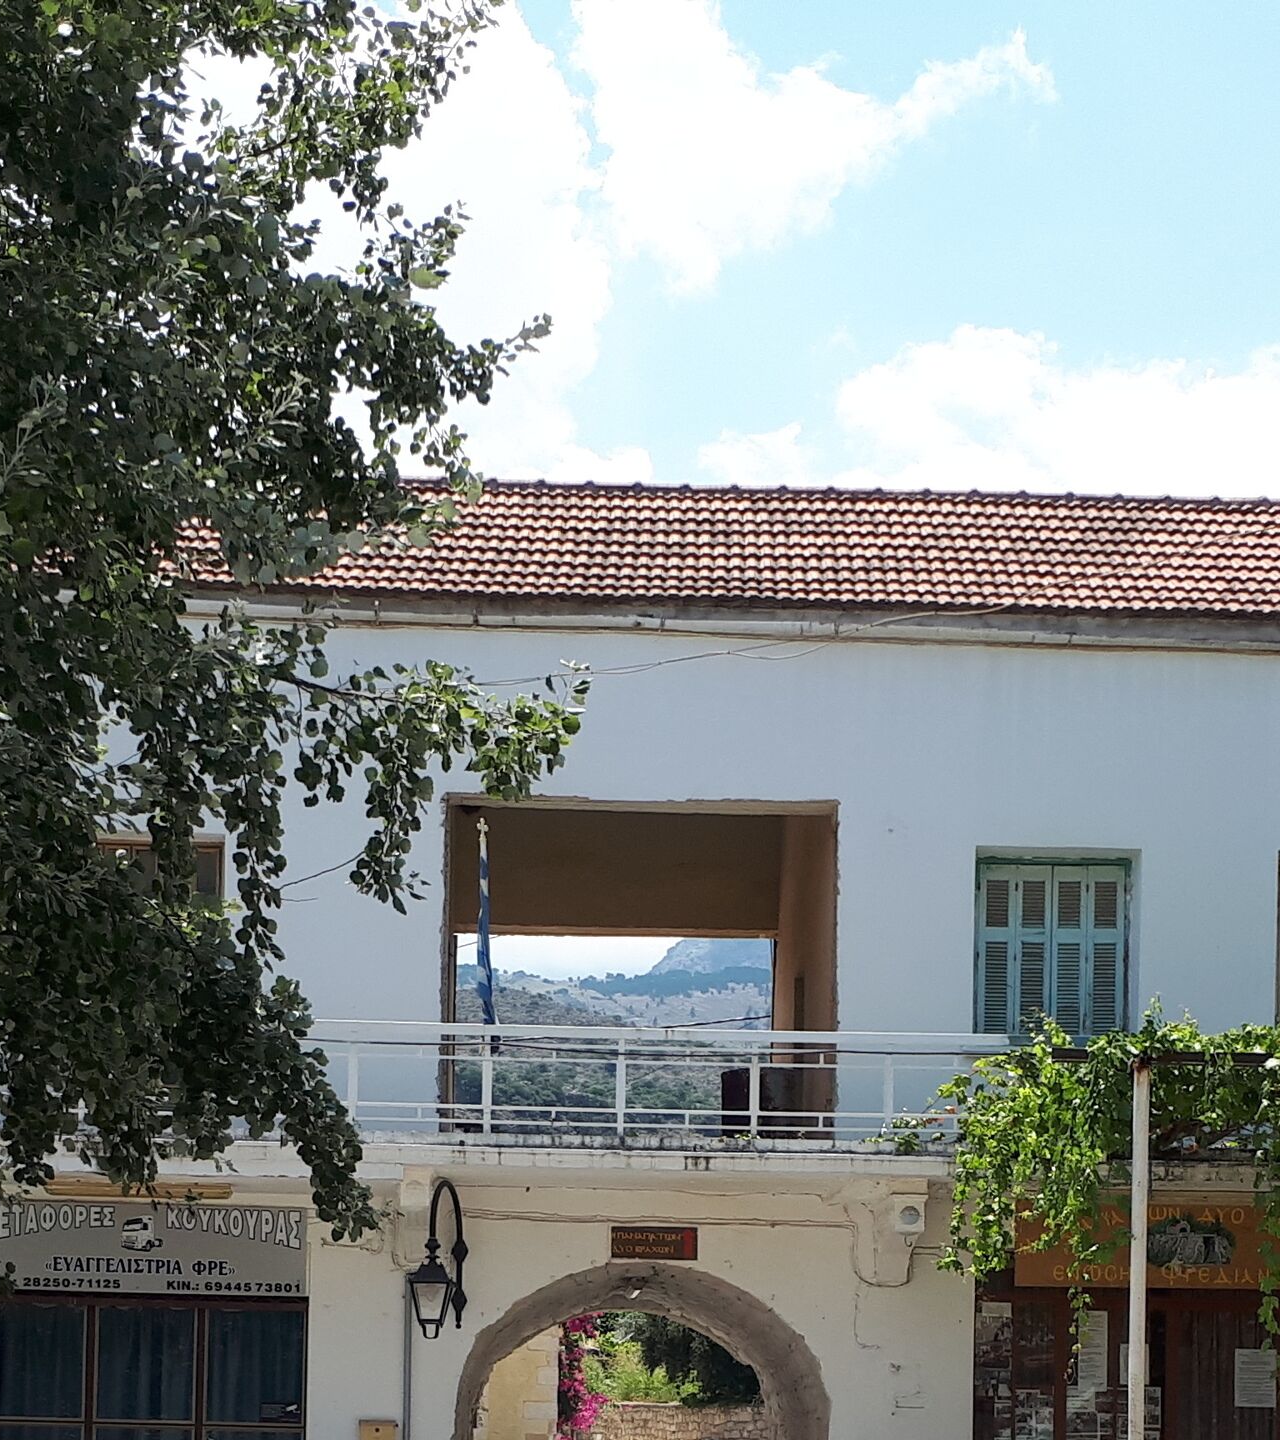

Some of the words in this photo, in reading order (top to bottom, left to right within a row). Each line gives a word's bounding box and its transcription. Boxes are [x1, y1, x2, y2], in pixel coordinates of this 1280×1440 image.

[166, 1207, 302, 1250] ΚΟΥΚΟΥΡΑΣ
[23, 1276, 121, 1289] 28250-71125
[204, 1280, 301, 1293] 6944573801
